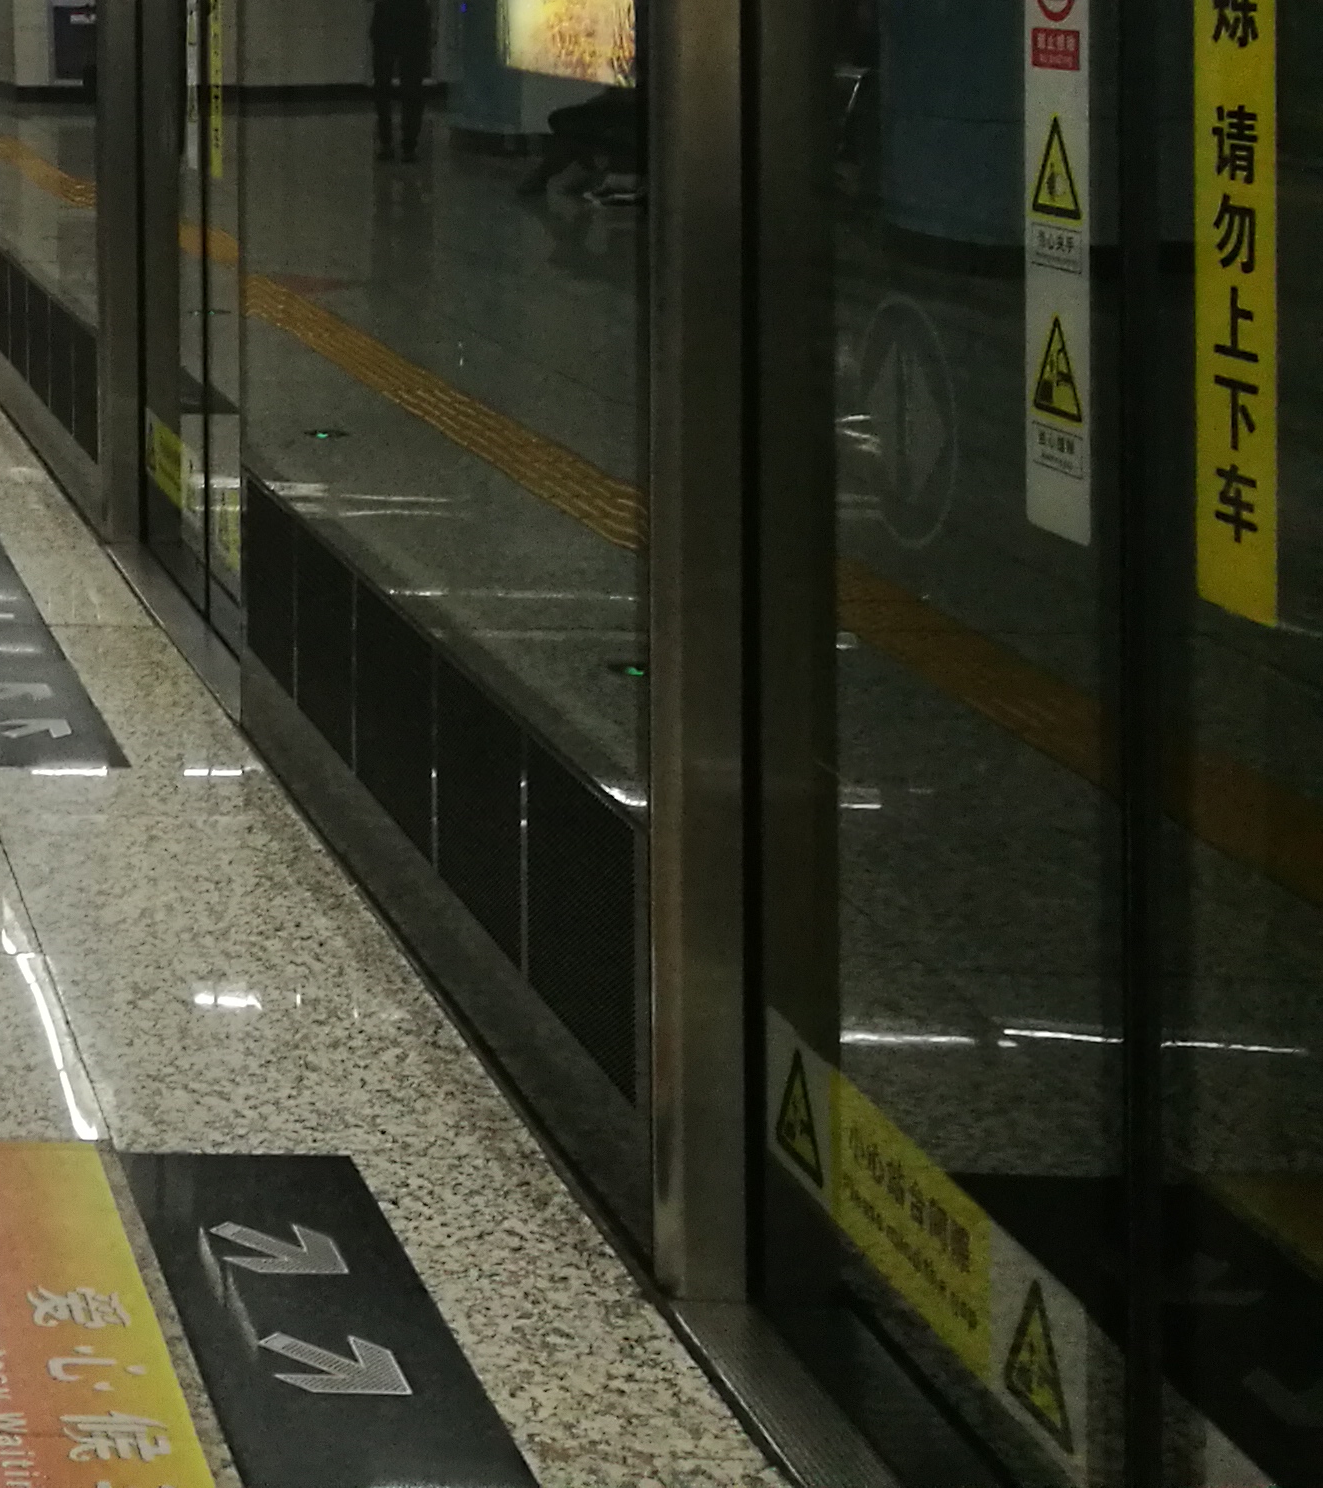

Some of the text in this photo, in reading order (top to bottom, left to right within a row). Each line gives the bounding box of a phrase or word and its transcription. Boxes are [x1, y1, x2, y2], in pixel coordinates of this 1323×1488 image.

[1210, 103, 1261, 544] 请勿上下车
